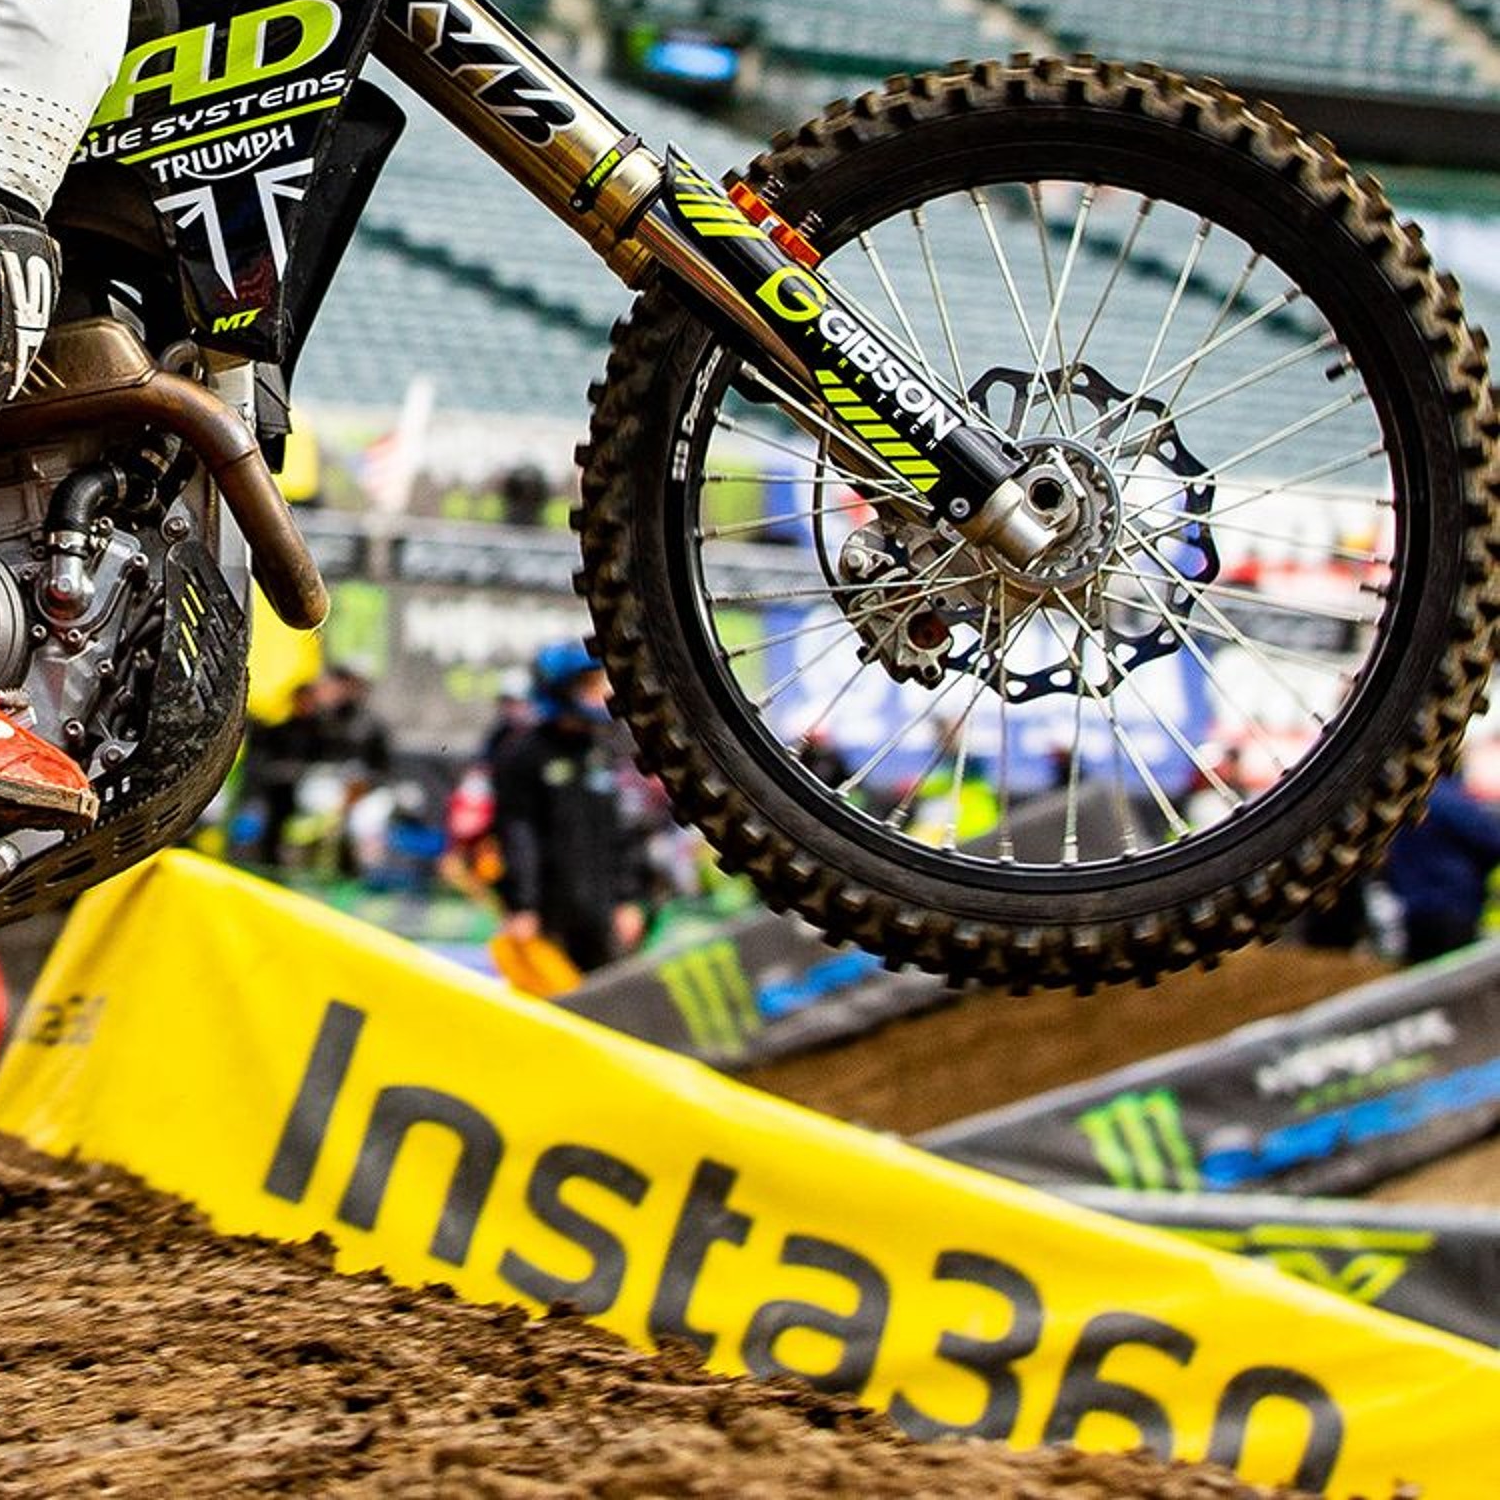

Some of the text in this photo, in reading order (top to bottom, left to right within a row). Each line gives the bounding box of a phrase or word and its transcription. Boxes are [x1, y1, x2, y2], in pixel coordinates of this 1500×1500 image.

[151, 70, 348, 142] SYSTEMS
[151, 125, 296, 184] TRIUMPH
[818, 308, 965, 441] GIBSON
